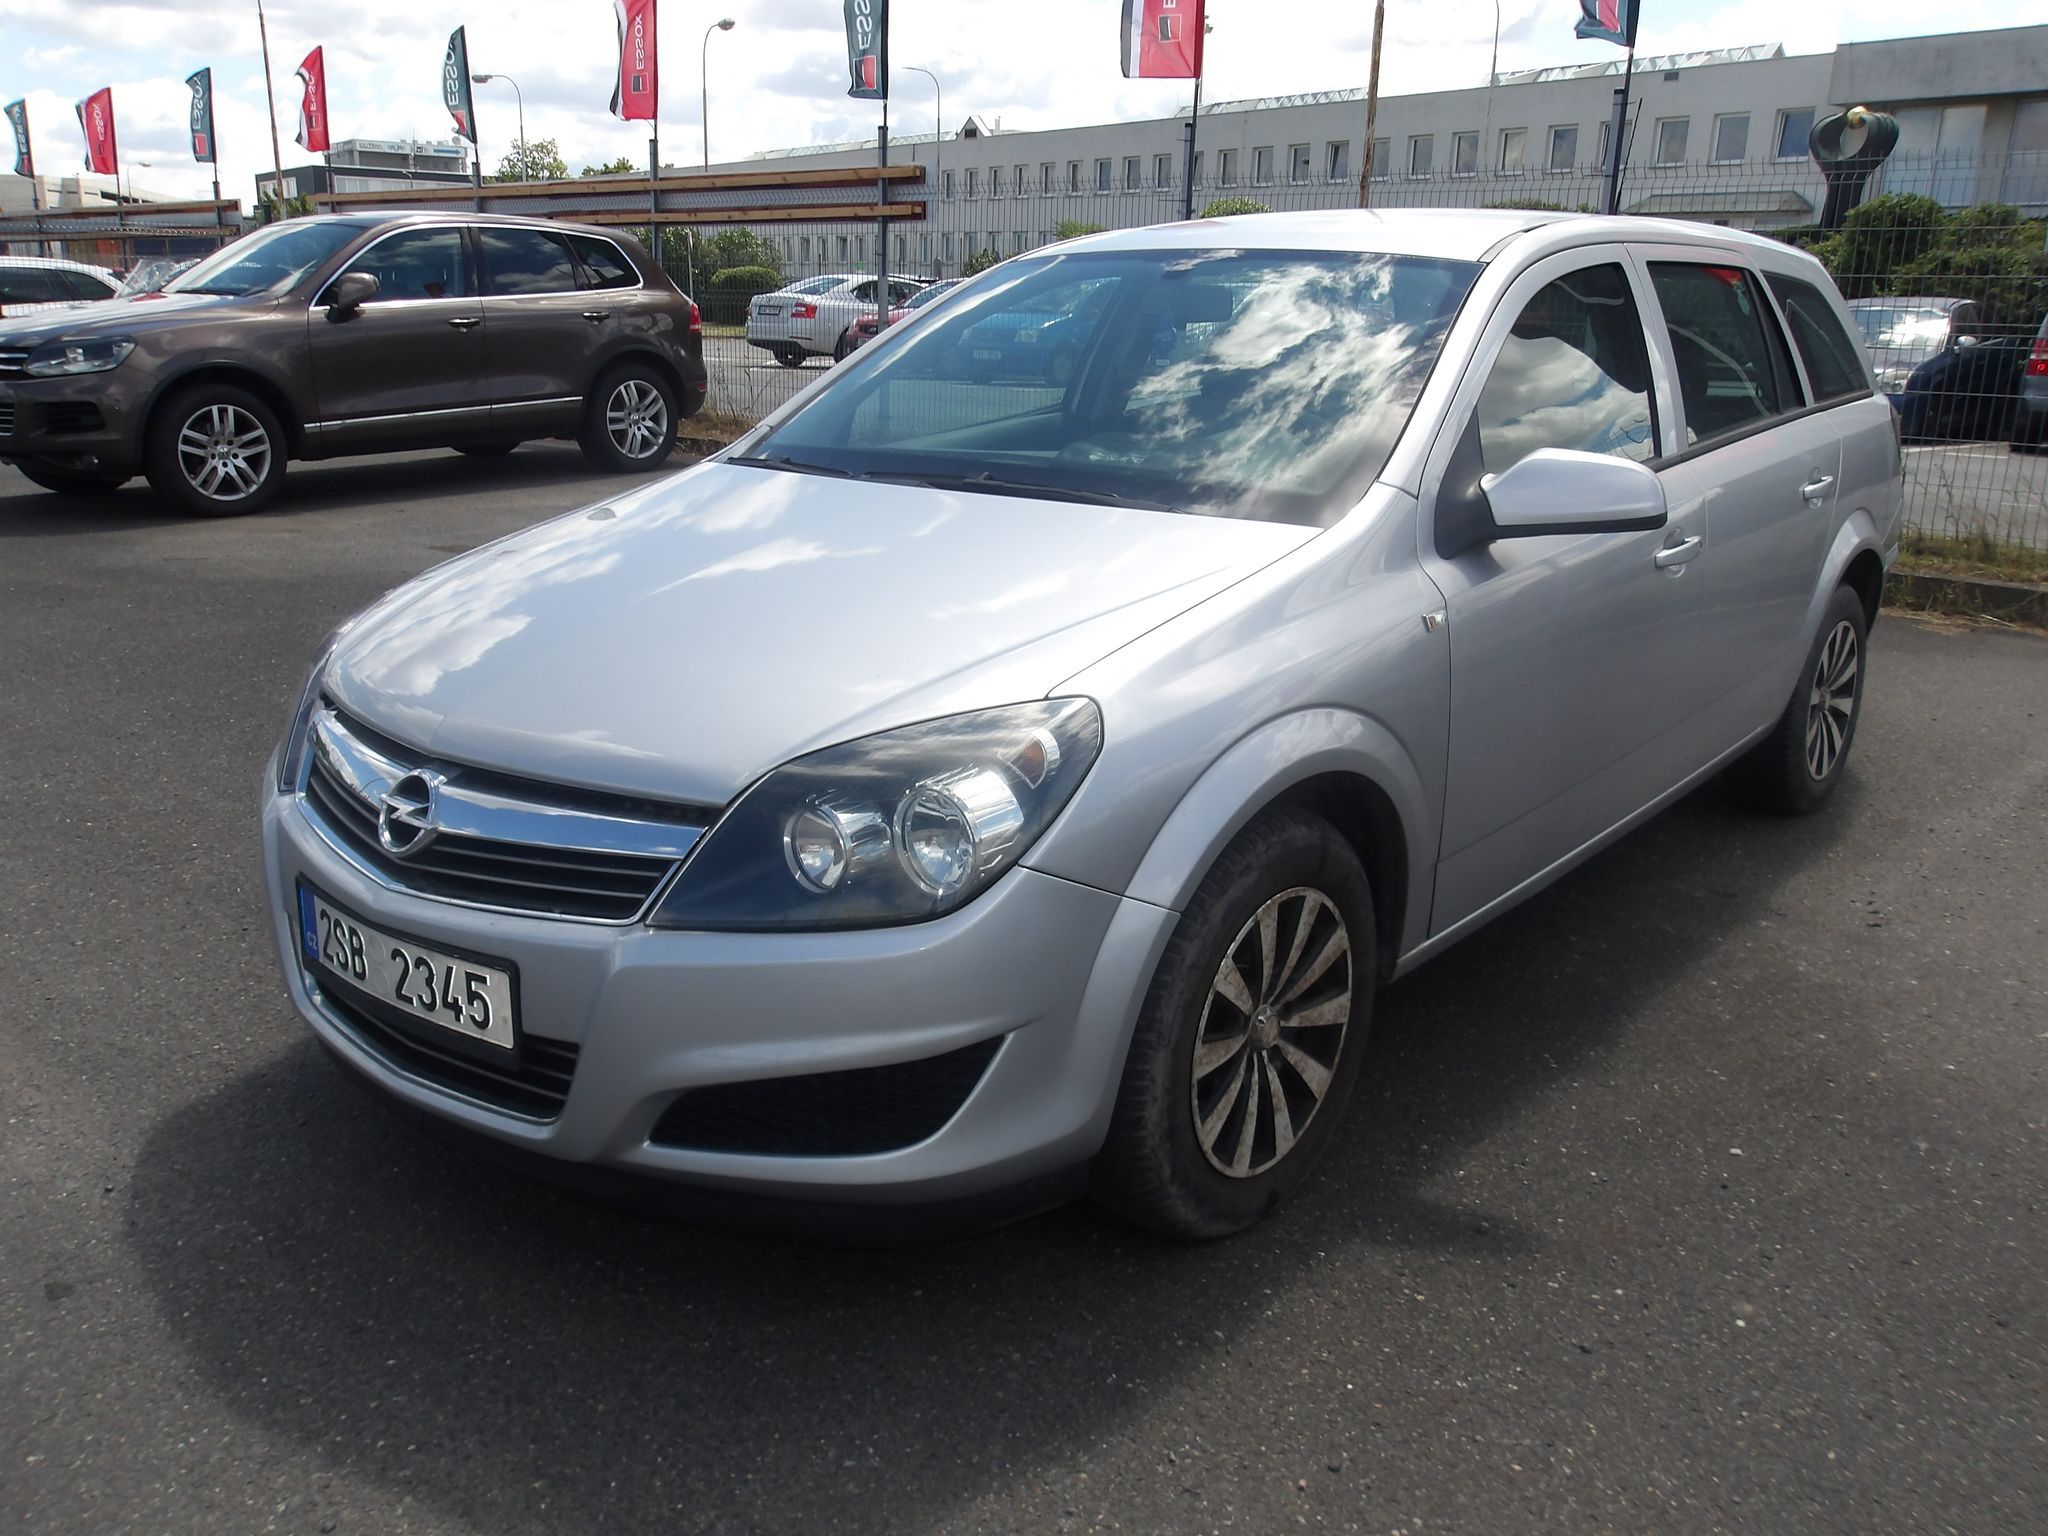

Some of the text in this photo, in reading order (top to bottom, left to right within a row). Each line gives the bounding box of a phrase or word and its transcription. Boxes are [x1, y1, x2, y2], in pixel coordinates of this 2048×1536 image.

[306, 930, 318, 950] CZ
[320, 908, 493, 1030] 2SB 2345
